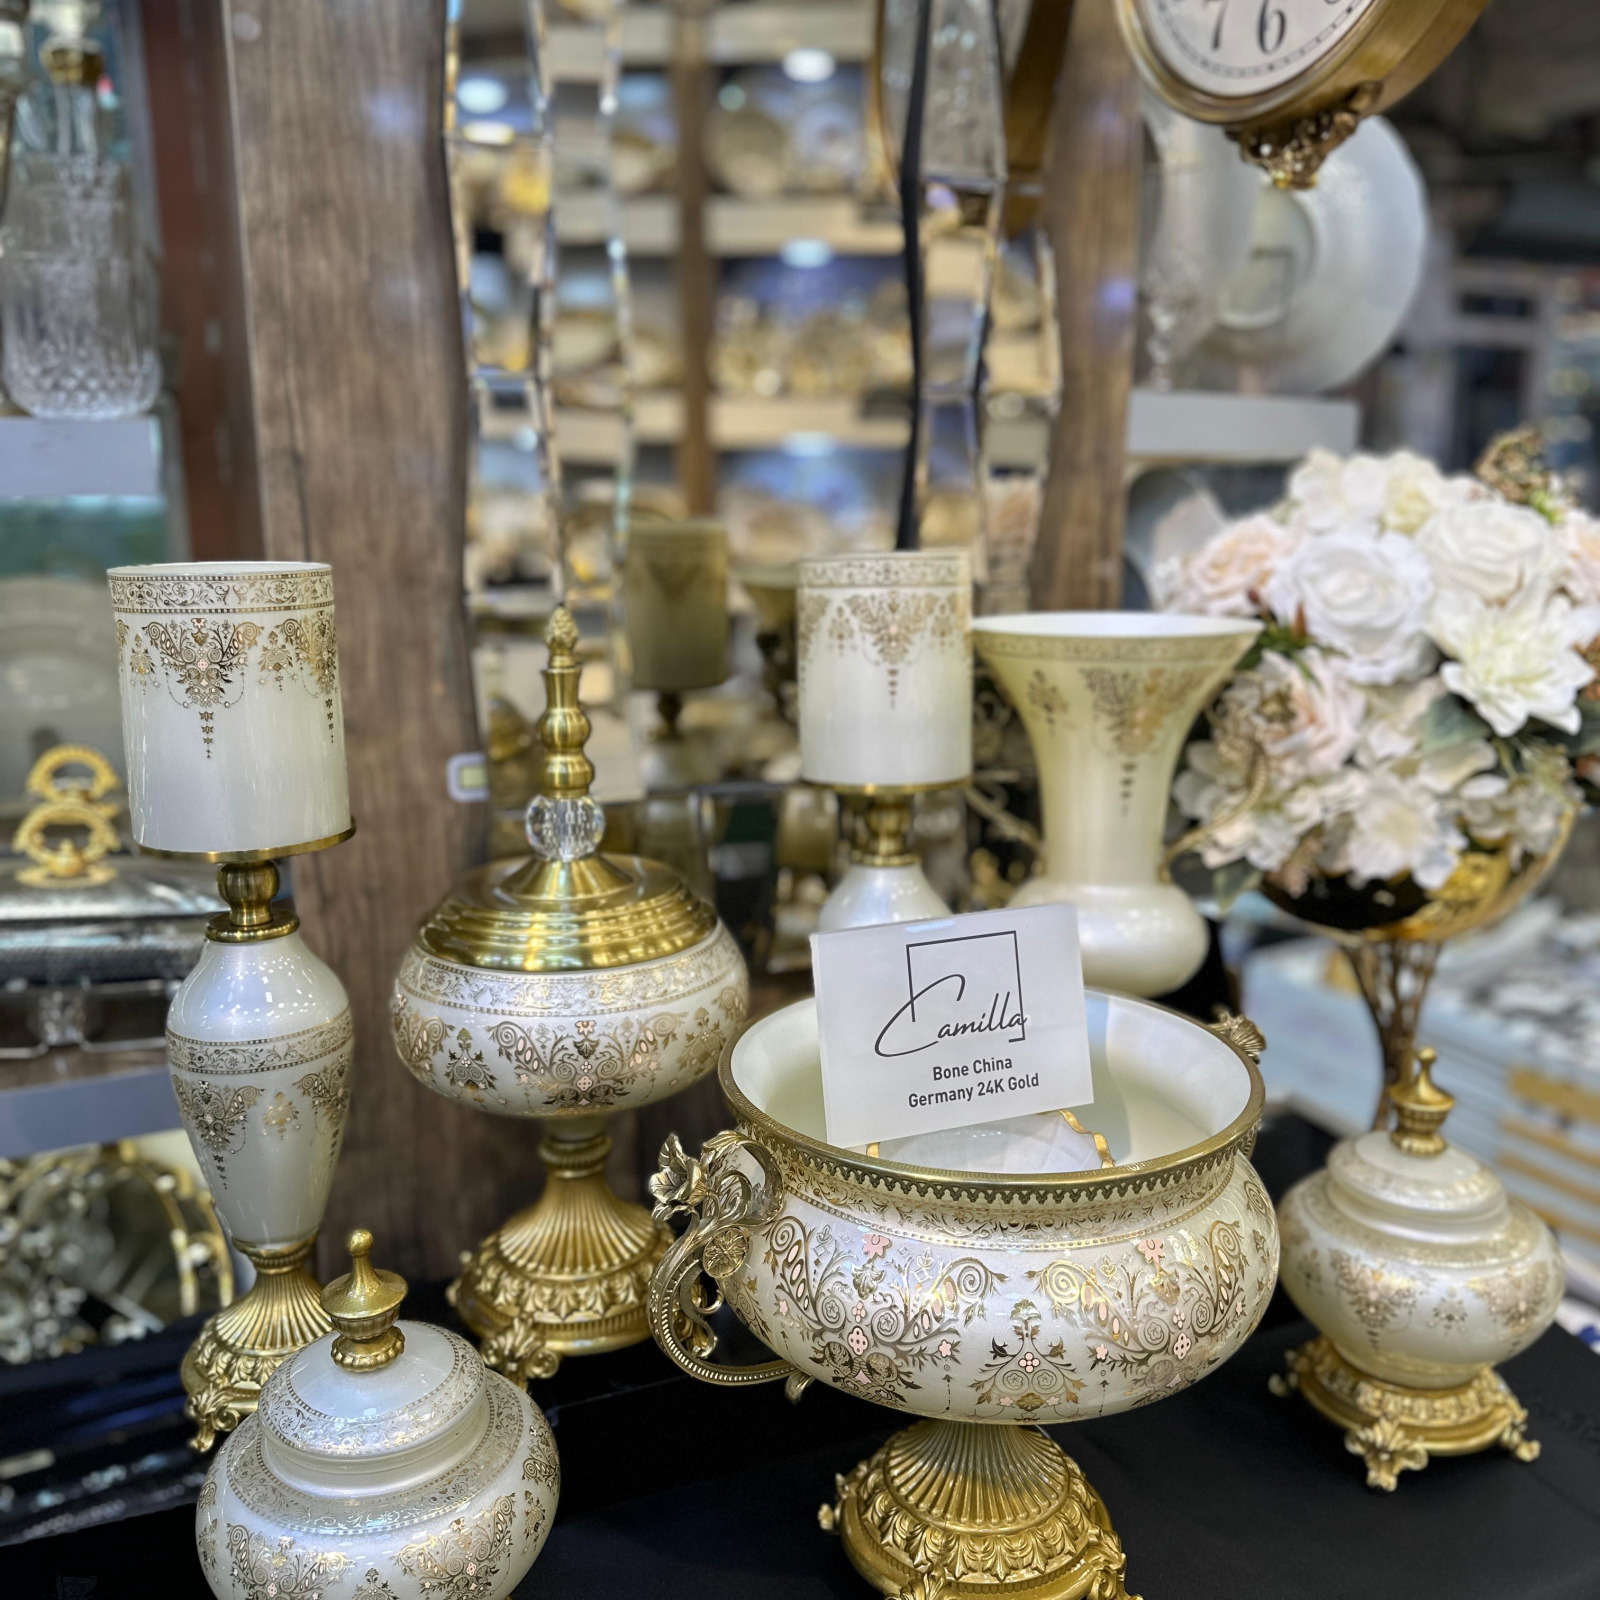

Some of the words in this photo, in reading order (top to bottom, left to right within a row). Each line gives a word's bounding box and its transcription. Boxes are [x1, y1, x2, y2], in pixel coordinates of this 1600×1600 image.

[1257, 0, 1287, 54] 6
[874, 973, 1028, 1058] Camilla
[908, 1085, 974, 1108] Germany
[977, 1078, 1005, 1096] 24K
[1008, 1073, 1039, 1091] Gold
[933, 1065, 969, 1081] Bone
[973, 1057, 1013, 1074] China
